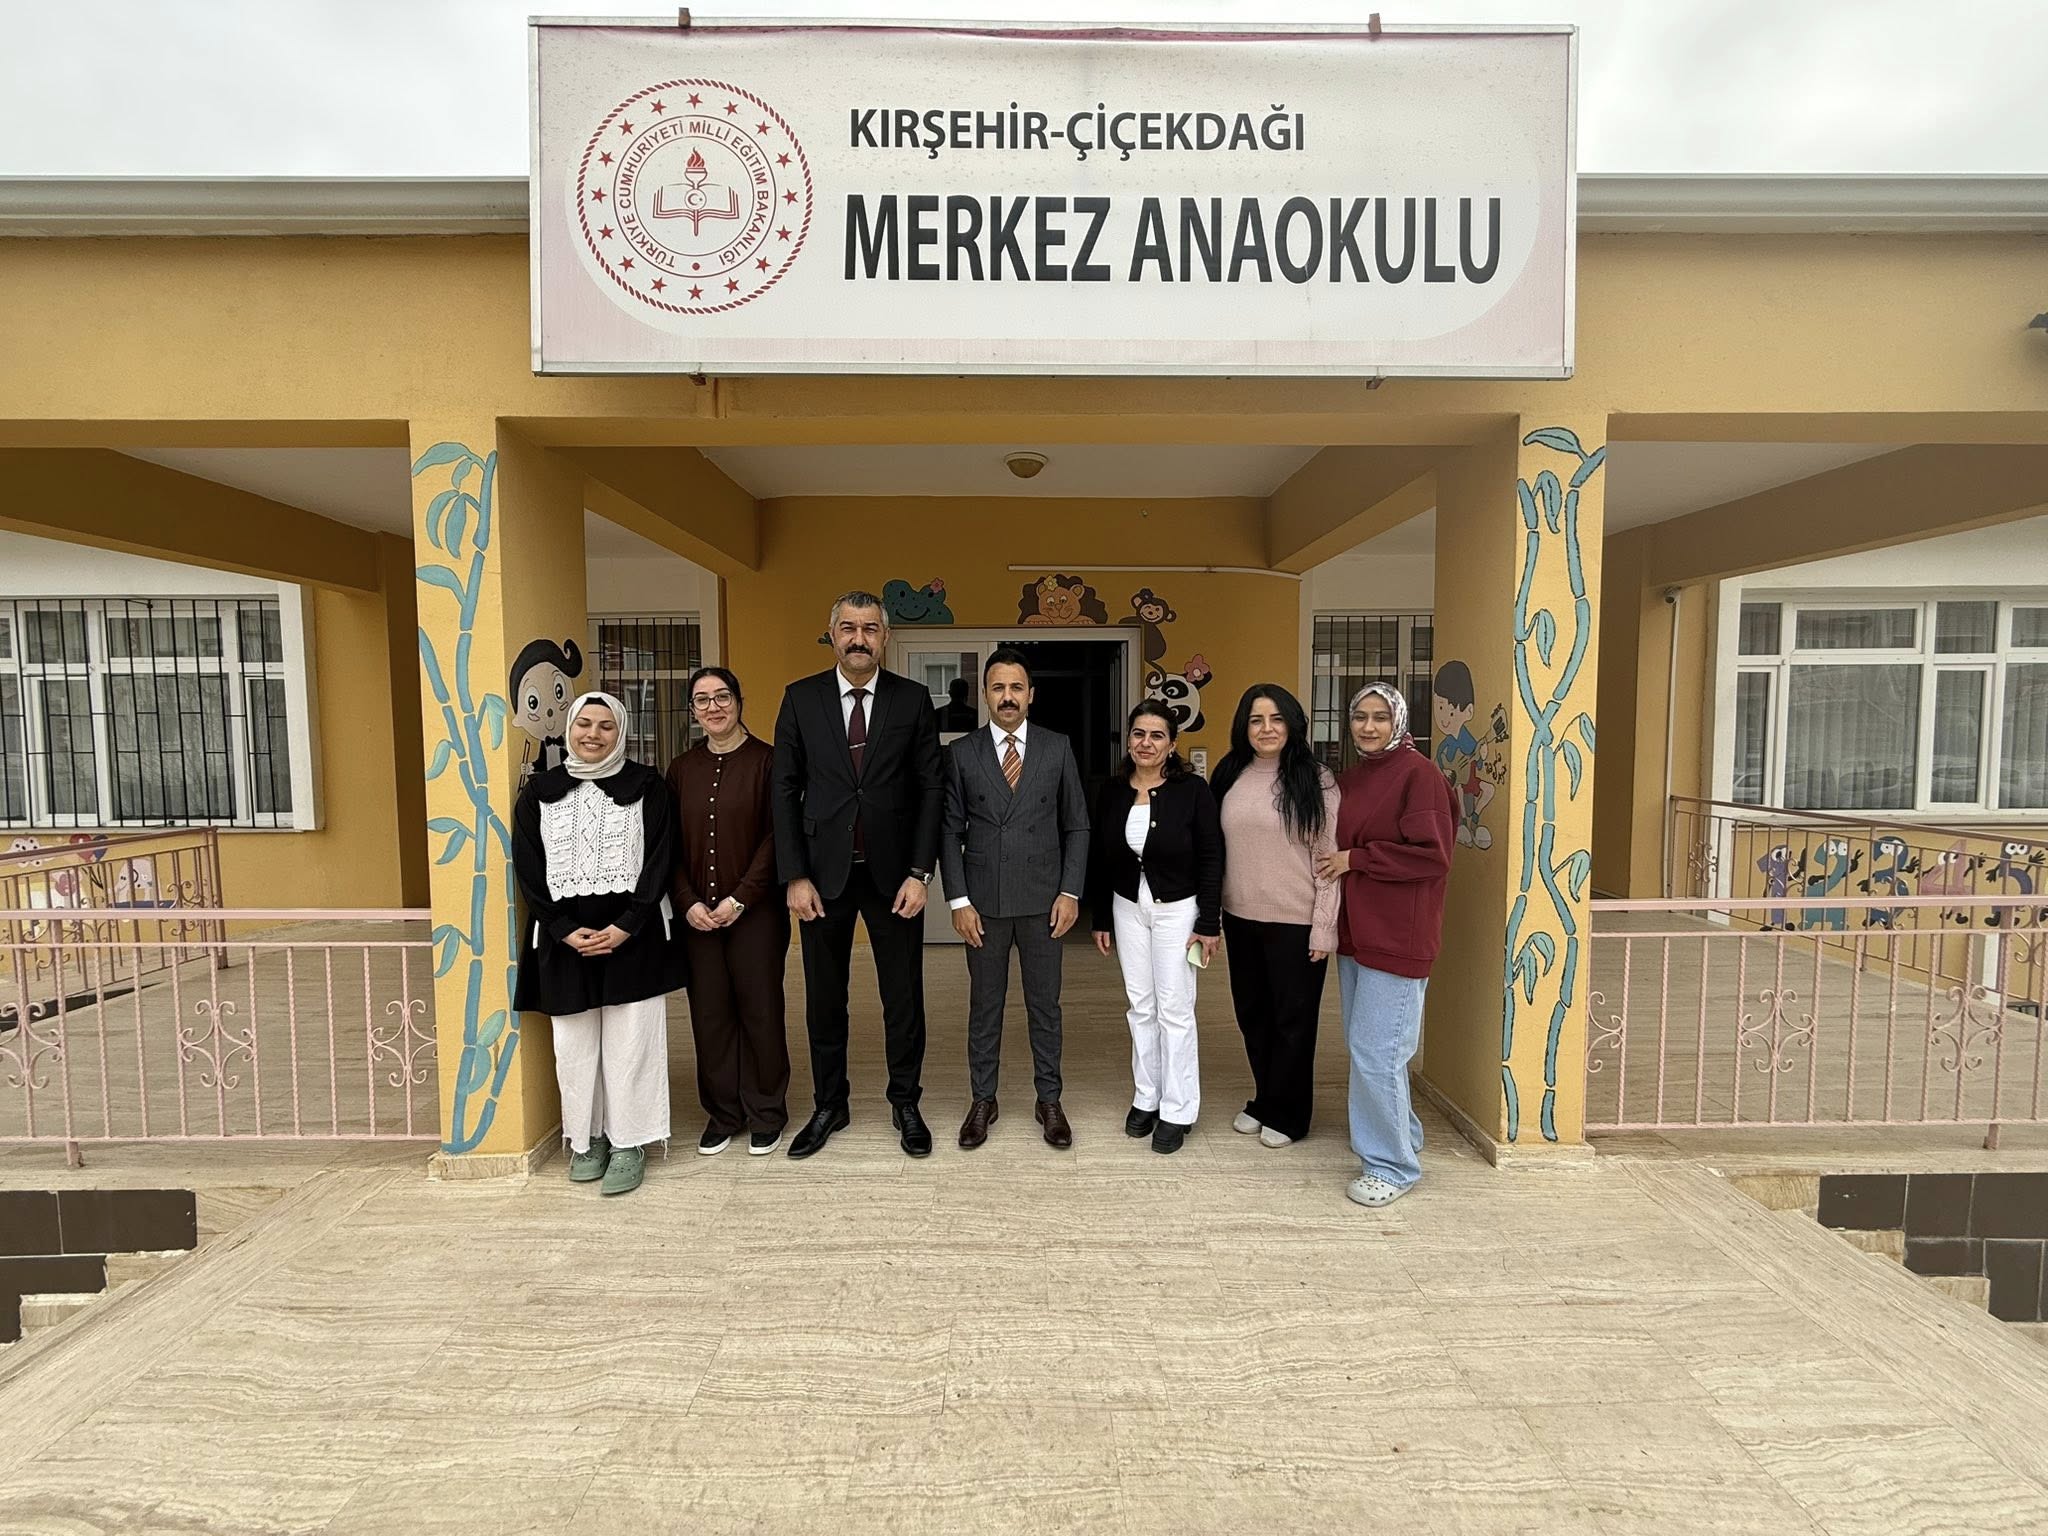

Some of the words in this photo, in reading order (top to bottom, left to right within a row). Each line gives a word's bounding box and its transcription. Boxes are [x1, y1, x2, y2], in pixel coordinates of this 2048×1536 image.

[689, 120, 732, 140] MİLLİ
[850, 102, 1304, 161] KIRŞEHİR-ÇİÇEKDAĞI
[619, 120, 684, 209] CUMHURİYETİ
[731, 137, 767, 185] EĞİTİM
[622, 214, 675, 268] TÜRKİYE
[719, 190, 769, 266] BAKANLIĞI
[845, 195, 1110, 282] MERKEZ
[1129, 197, 1500, 284] ANAOKULU
